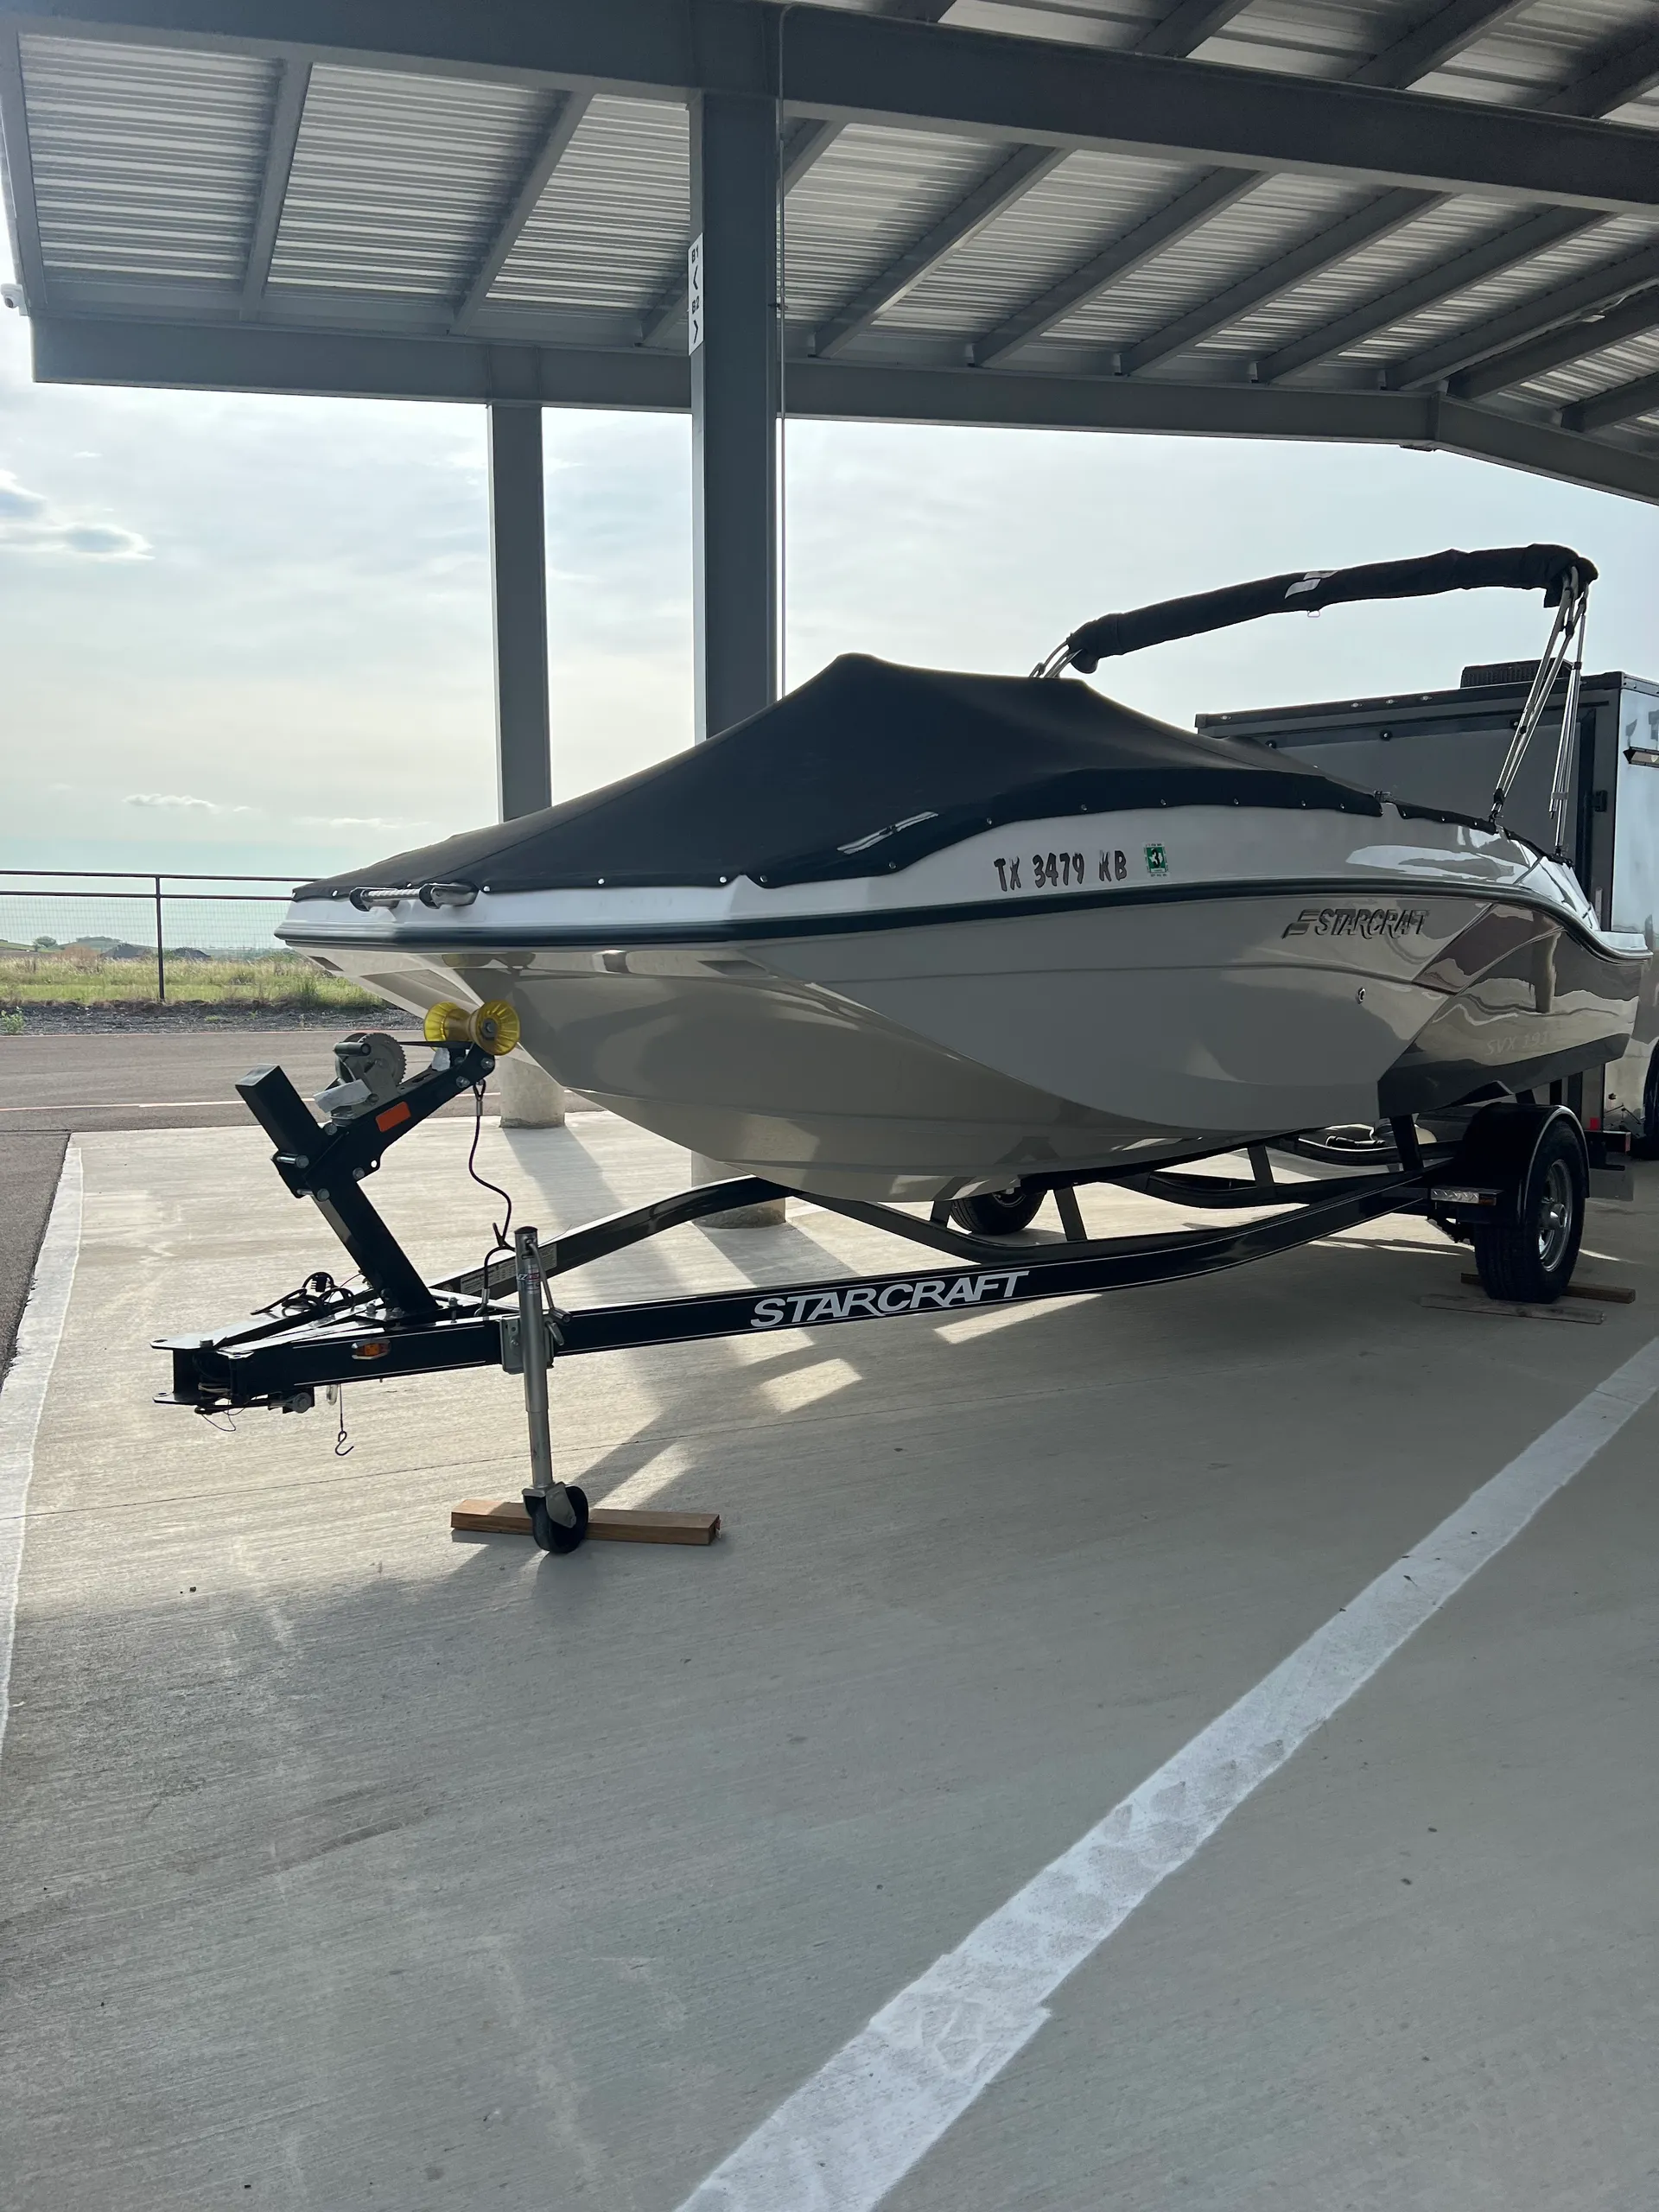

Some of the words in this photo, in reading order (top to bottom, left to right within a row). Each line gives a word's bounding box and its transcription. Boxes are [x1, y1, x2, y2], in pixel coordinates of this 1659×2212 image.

[692, 245, 699, 264] B1
[692, 296, 699, 315] B2
[994, 855, 1021, 892] TX
[1033, 852, 1085, 888] 3479
[1099, 849, 1128, 882] KB
[1315, 908, 1431, 939] STARCRAFT
[750, 1270, 1030, 1327] STARCRAFT
